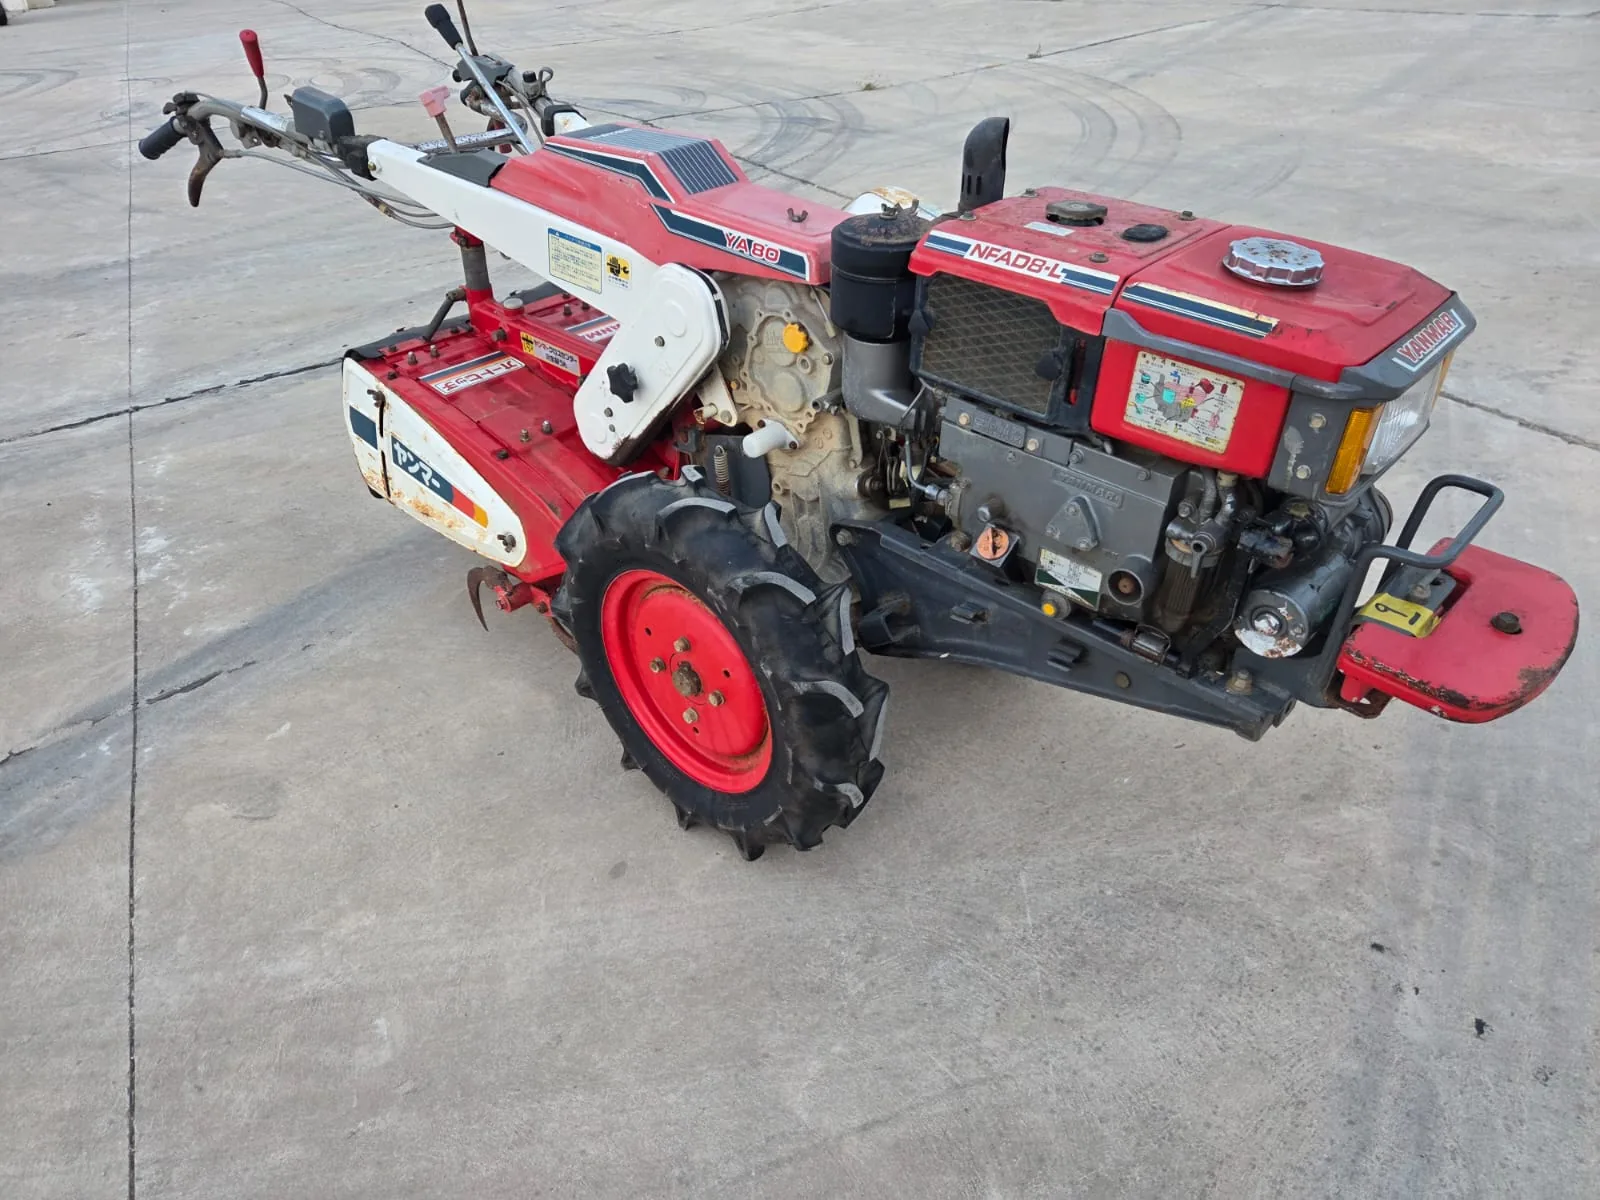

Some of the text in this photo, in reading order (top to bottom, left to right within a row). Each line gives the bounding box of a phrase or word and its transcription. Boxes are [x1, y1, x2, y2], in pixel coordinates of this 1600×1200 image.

[725, 232, 780, 263] YA80
[1397, 311, 1458, 364] YANMAR
[393, 441, 441, 489] ヤンマー
